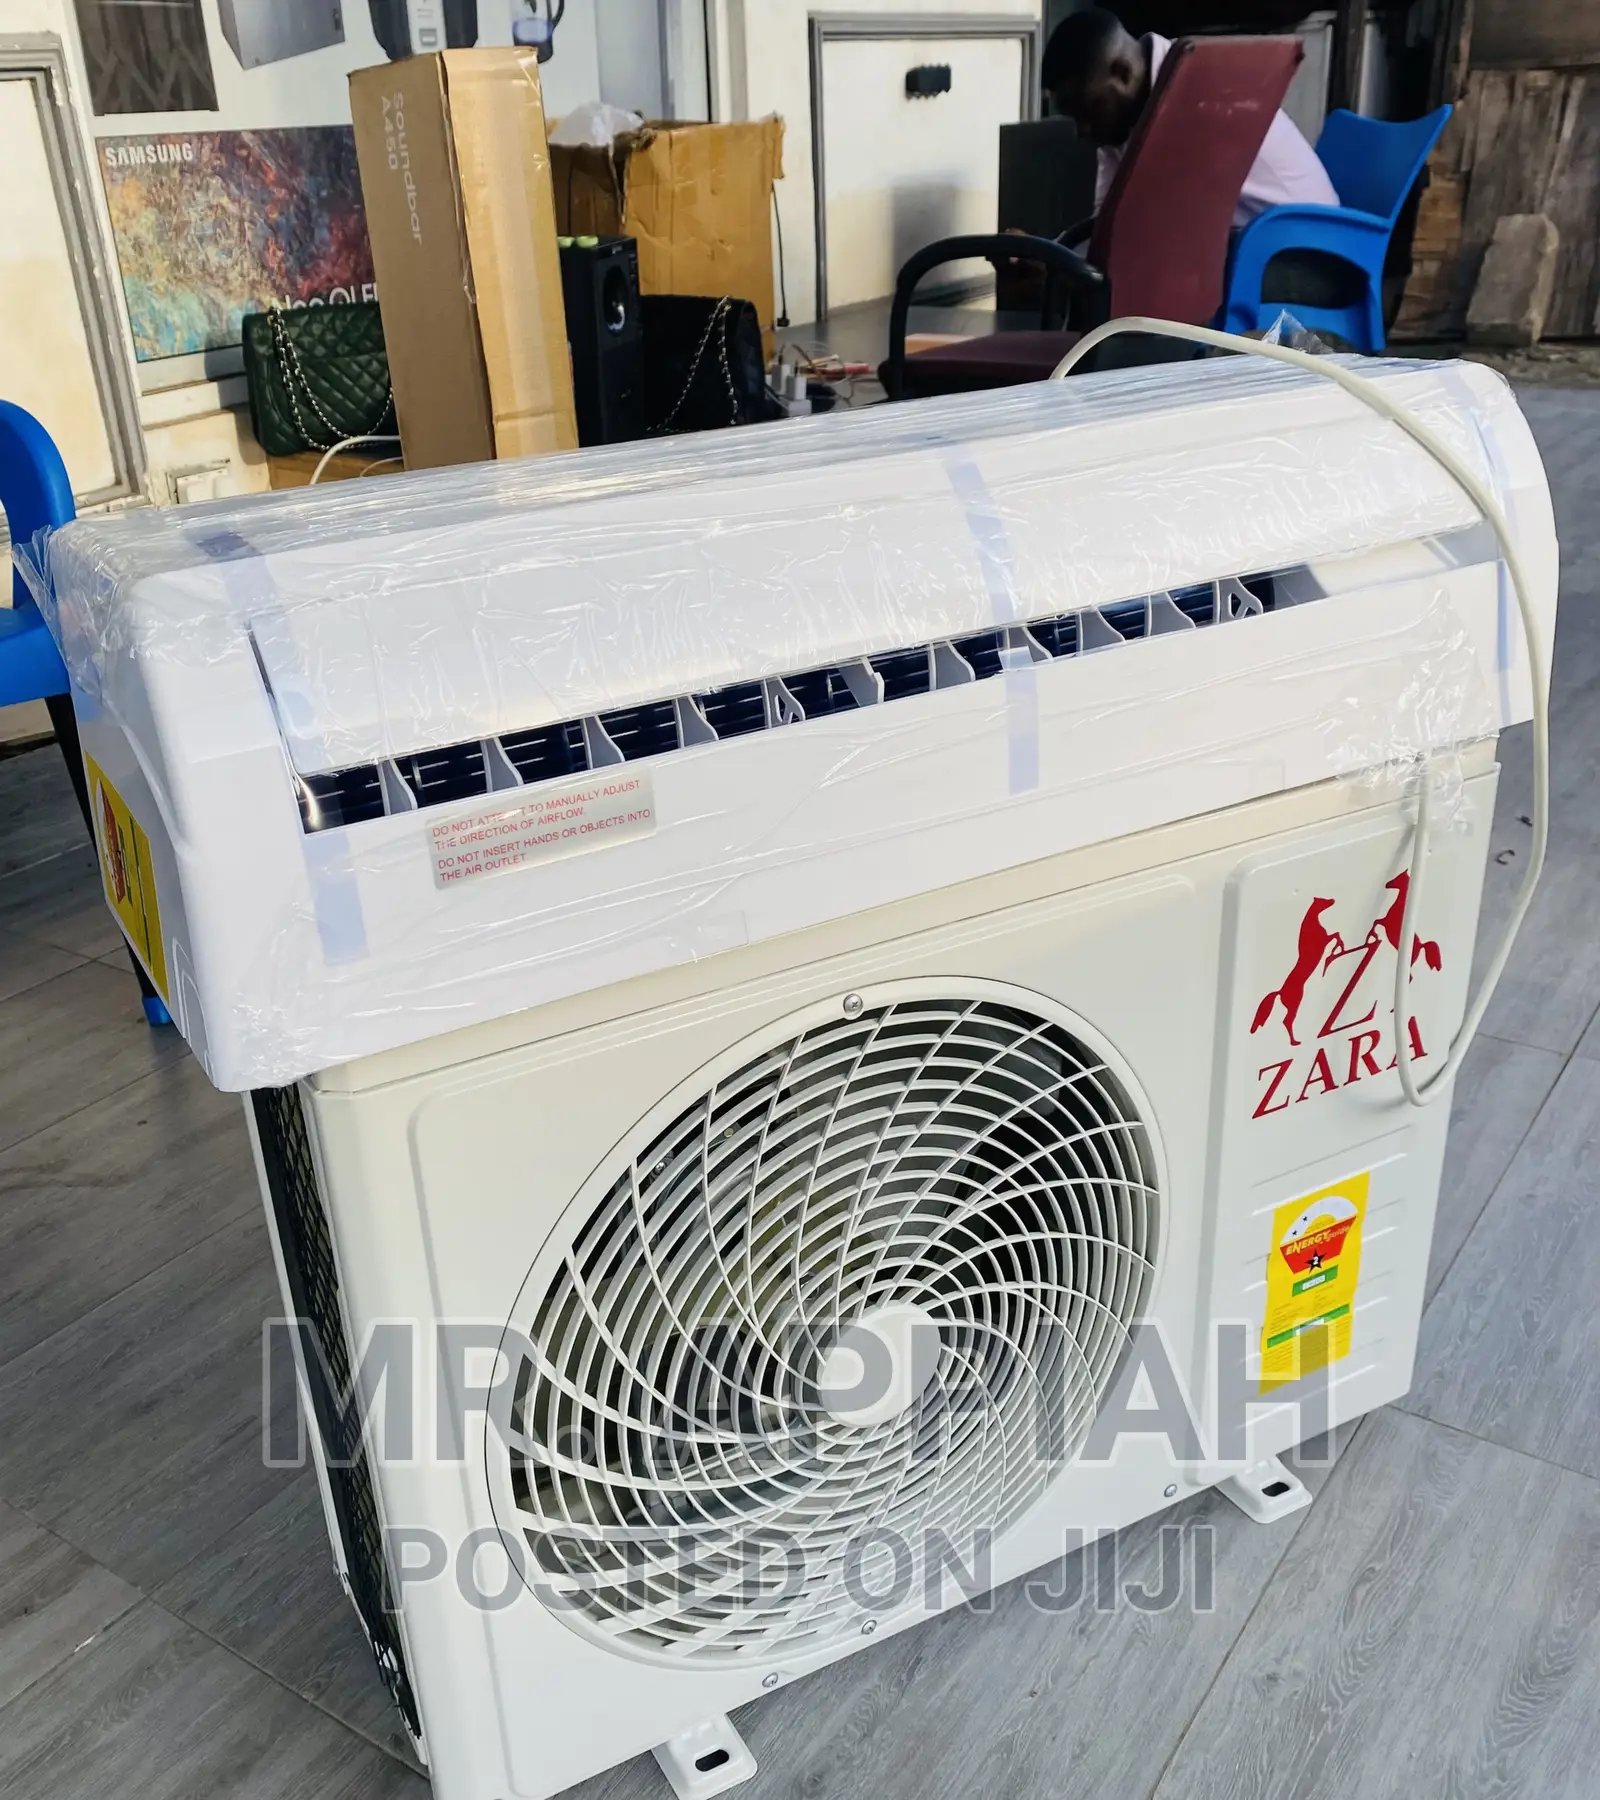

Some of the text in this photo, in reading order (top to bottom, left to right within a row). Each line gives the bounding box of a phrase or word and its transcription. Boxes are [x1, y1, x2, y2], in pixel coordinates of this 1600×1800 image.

[104, 143, 194, 167] SAMSUNG
[381, 96, 398, 170] A450
[393, 91, 422, 245] Soundbar
[432, 780, 640, 837] DO NOT ATTET TO MANUALLY ADJUST
[434, 837, 457, 851] THE
[459, 824, 518, 845] DIRECTION
[520, 818, 535, 829] OF
[438, 808, 651, 869] DO NOT INSERT HANDS OR OBJECTS INTO
[440, 853, 526, 882] THE AIR OUTLET
[1251, 1015, 1429, 1120] ZARA
